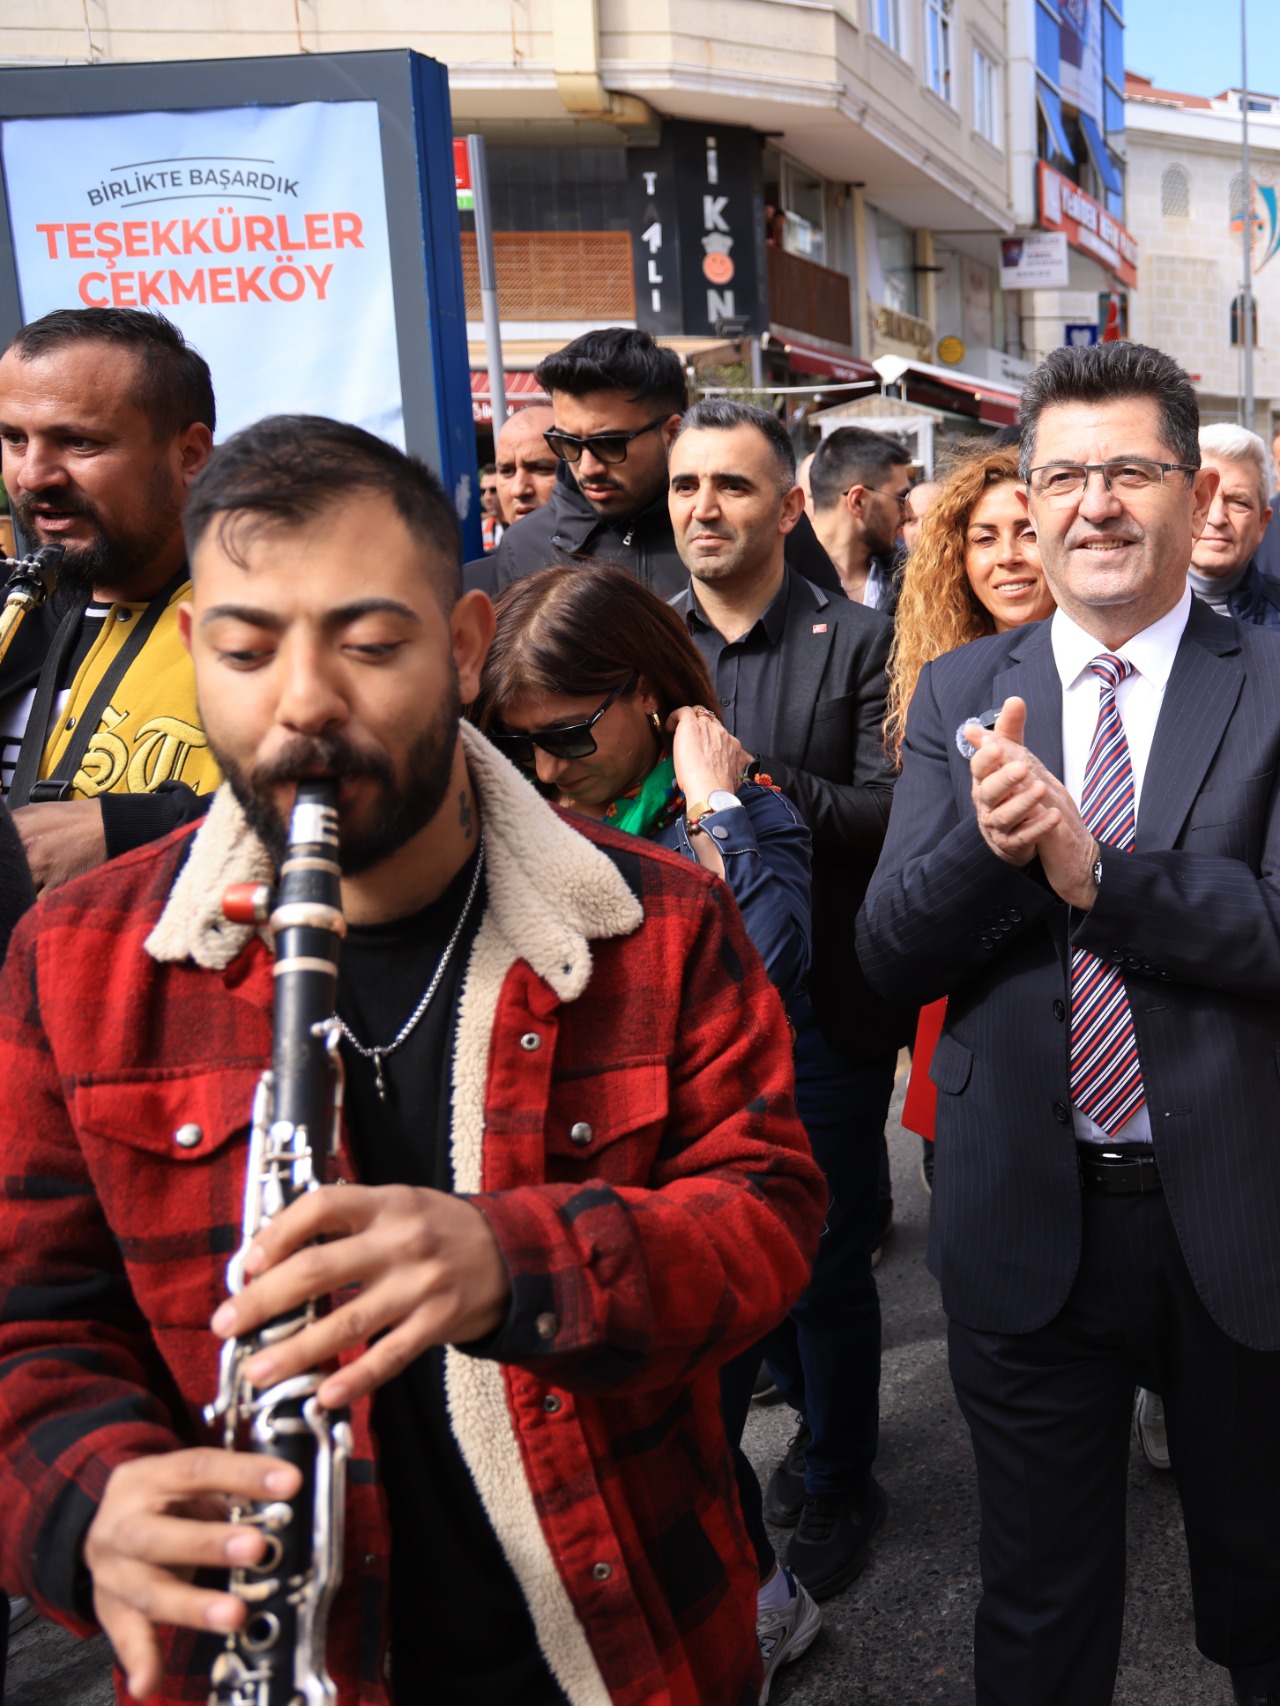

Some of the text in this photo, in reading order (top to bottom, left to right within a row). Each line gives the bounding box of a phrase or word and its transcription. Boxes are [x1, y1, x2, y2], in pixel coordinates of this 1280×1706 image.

[87, 169, 300, 206] BİRLİKTE BAŞARDIK
[36, 206, 365, 270] TEŞEKKÜRLER
